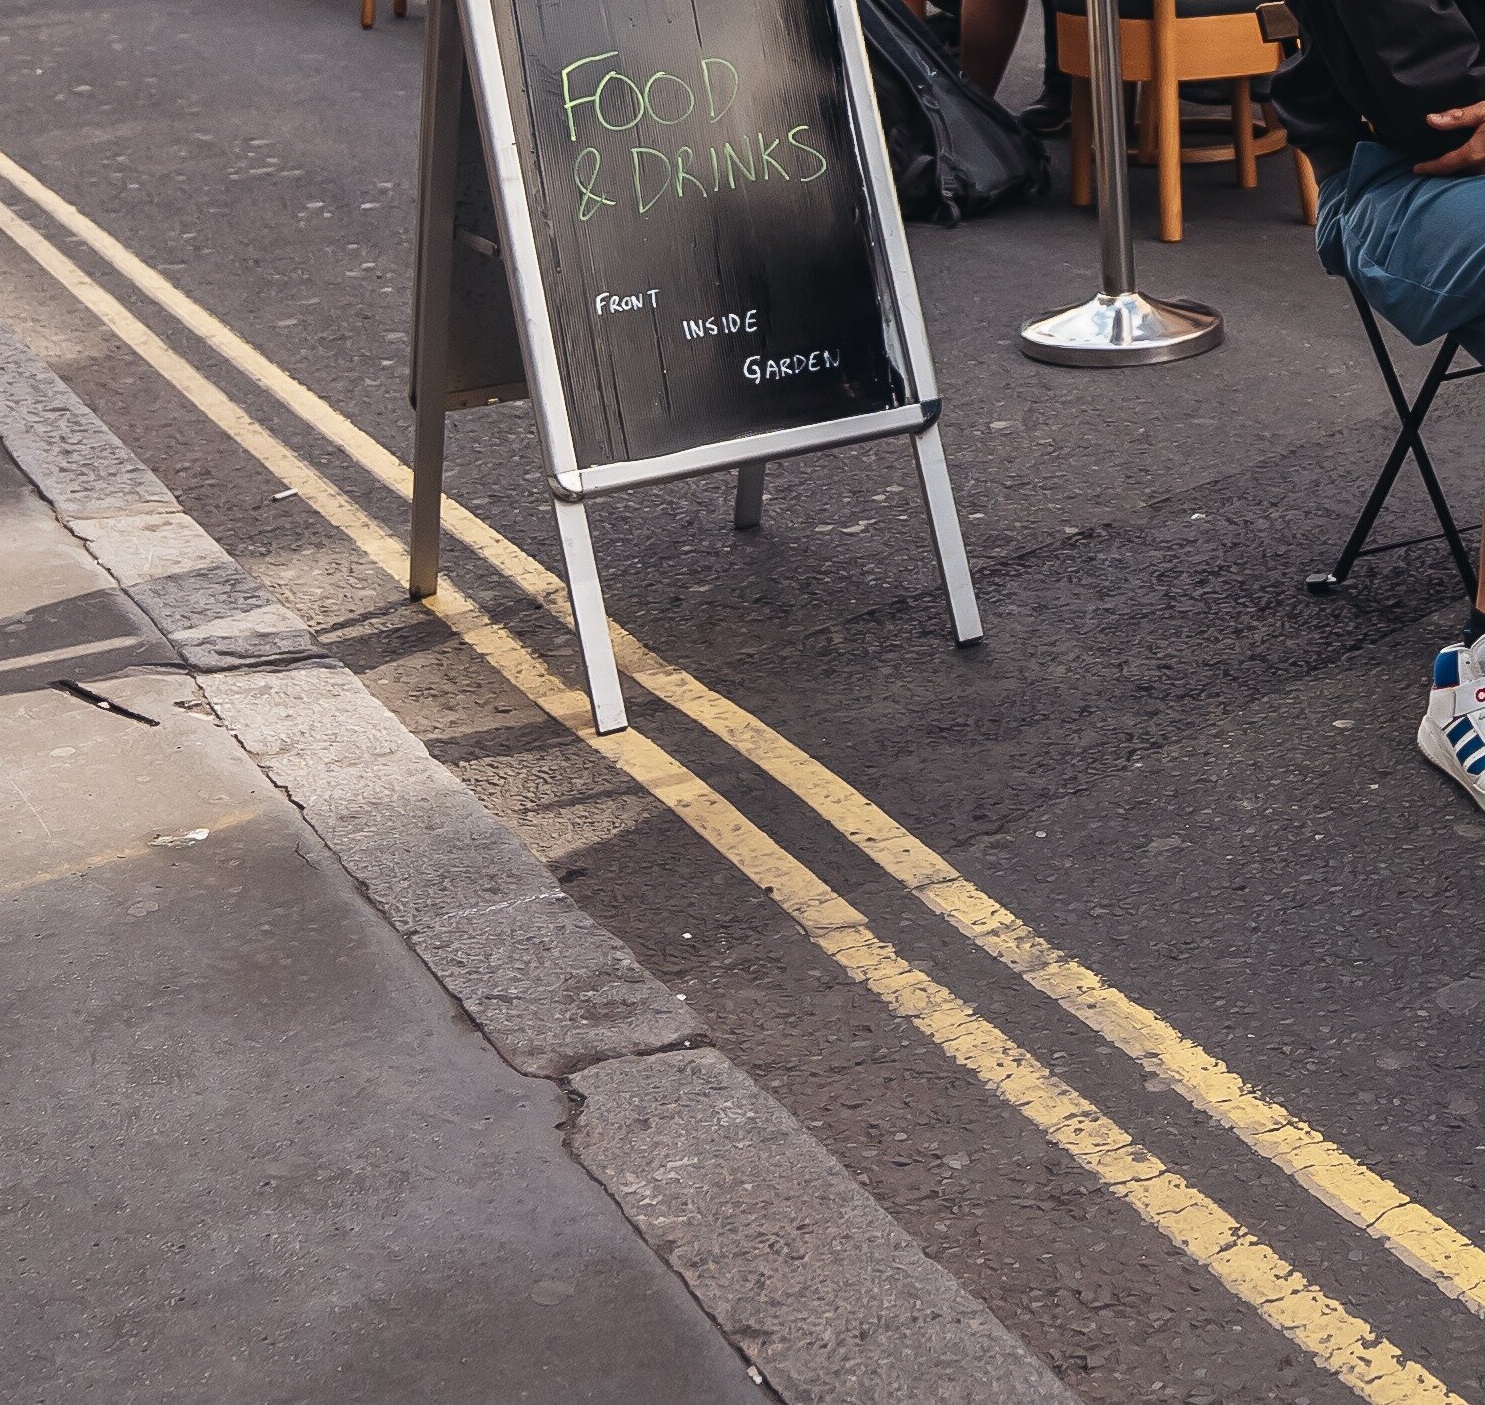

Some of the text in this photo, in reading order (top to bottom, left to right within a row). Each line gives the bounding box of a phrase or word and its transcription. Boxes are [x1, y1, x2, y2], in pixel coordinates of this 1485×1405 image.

[562, 51, 740, 142] FOOD
[573, 125, 827, 221] & DRINKS
[595, 288, 661, 316] FRONT
[682, 309, 758, 340] INSIDE
[743, 348, 841, 385] GARDEN
